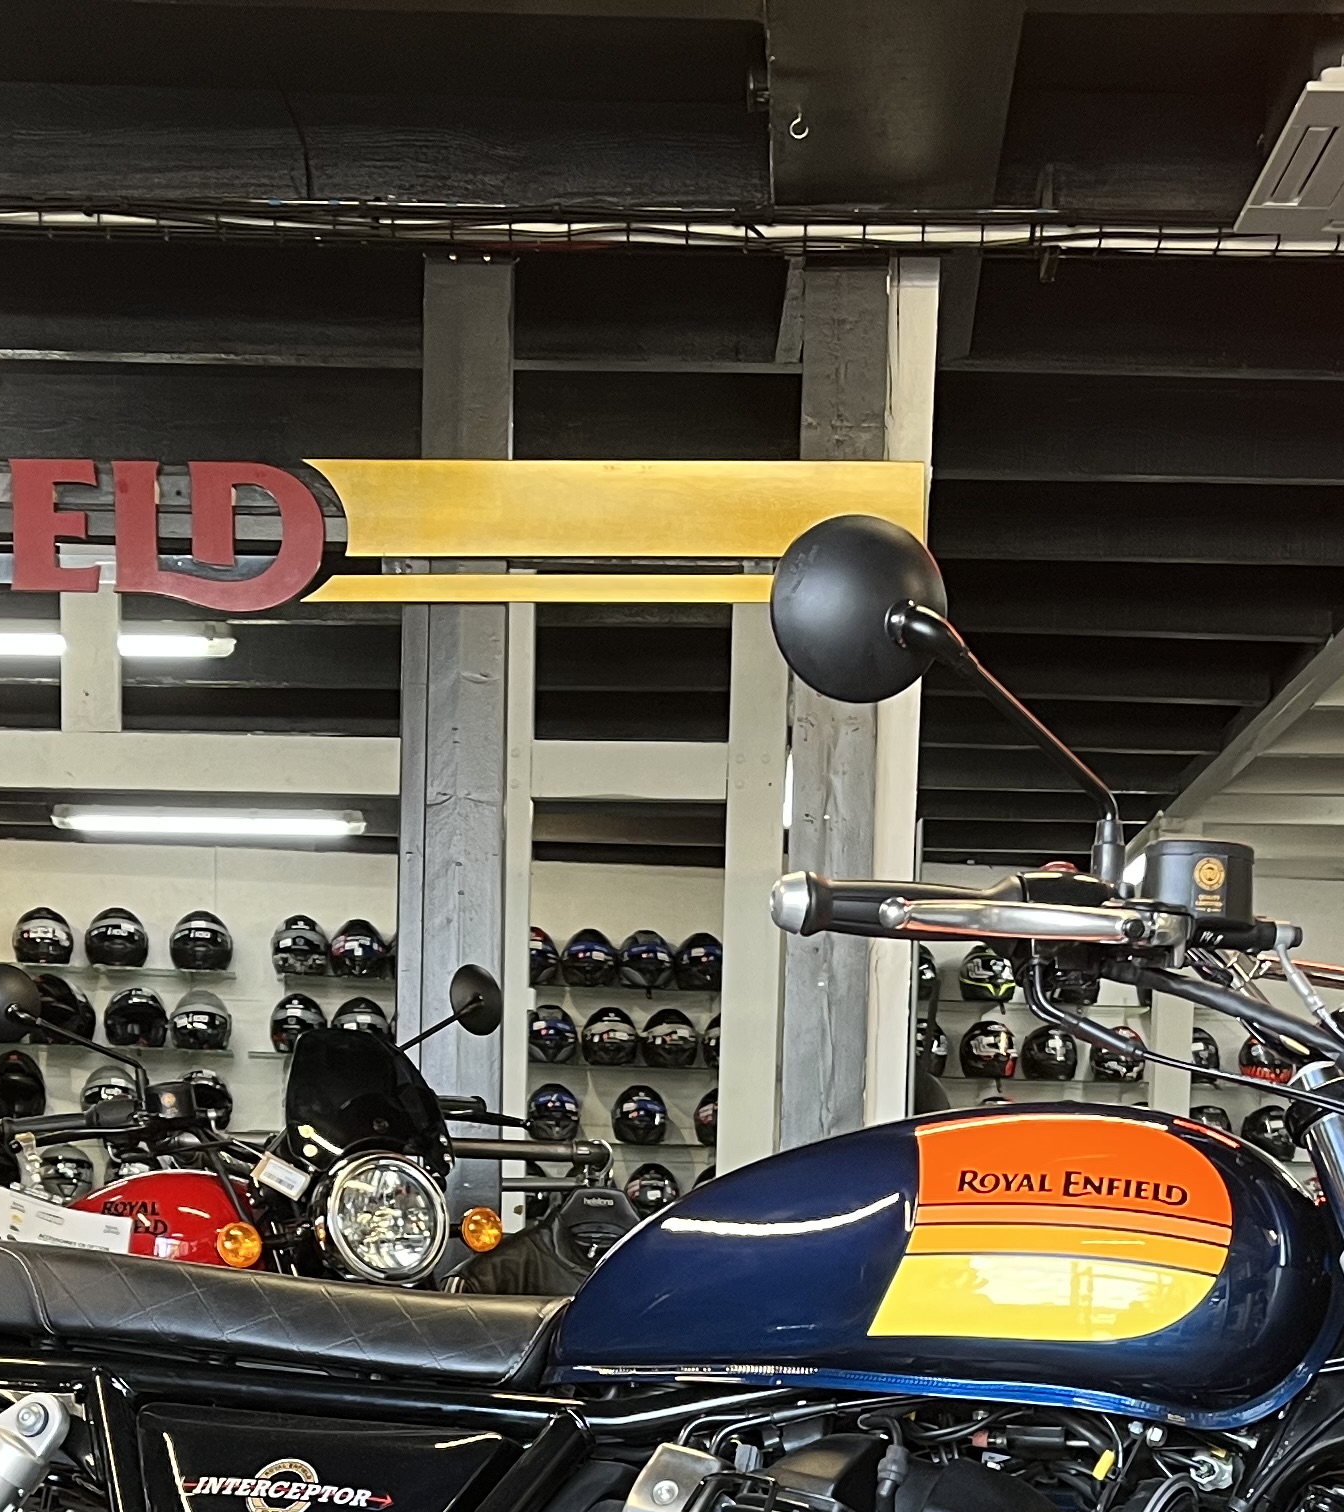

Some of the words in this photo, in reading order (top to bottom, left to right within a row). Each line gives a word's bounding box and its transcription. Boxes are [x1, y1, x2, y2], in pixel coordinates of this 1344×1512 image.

[957, 1169, 1053, 1194] ROYAL
[1062, 1170, 1189, 1206] ENFIELD
[102, 1201, 160, 1216] ROYAL
[192, 1476, 372, 1508] INTERCEPTOR
